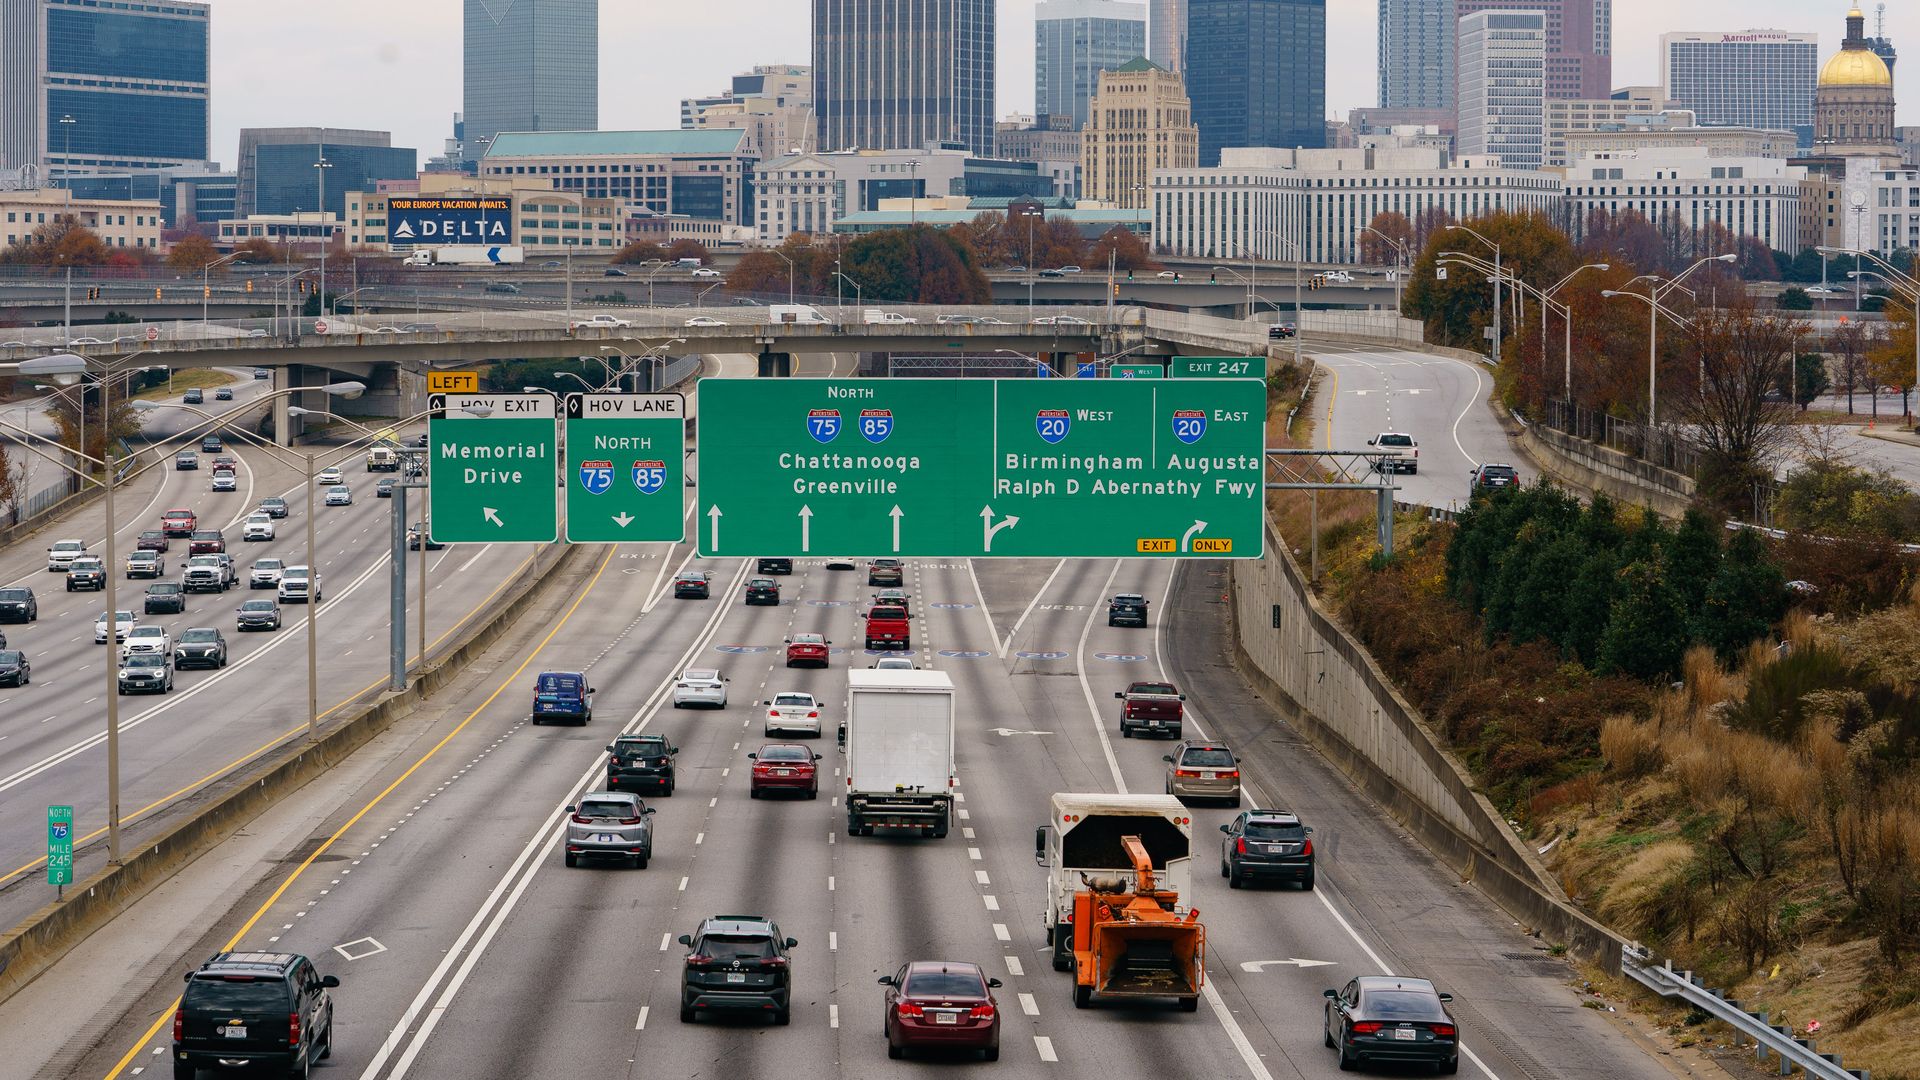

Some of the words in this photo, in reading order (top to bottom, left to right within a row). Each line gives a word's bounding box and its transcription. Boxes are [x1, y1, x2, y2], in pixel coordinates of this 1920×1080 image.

[1721, 34, 1757, 42] Marriott
[422, 220, 506, 236] DELTA
[1189, 363, 1212, 372] EXIT
[1218, 362, 1249, 374] 247
[434, 376, 472, 388] LEFT
[828, 386, 874, 398] NORTH
[505, 400, 540, 412] EXIT
[590, 400, 623, 412] HOV
[633, 400, 675, 412] LANE
[1077, 410, 1113, 421] WEST
[1214, 410, 1248, 422] EAST
[813, 420, 836, 435] 75
[864, 420, 888, 435] 85
[1042, 420, 1064, 436] 20
[1178, 420, 1200, 436] 20
[595, 436, 651, 449] NORTH
[442, 443, 545, 458] Memorial
[779, 454, 920, 473] Chattanooga
[1006, 454, 1143, 474] Birmingham
[1168, 454, 1259, 474] Augusta
[464, 468, 522, 484] Drive
[584, 469, 611, 488] 75
[636, 469, 663, 488] 85
[794, 478, 898, 494] Greenville
[998, 479, 1056, 498] Ralph
[1066, 480, 1080, 494] D
[1092, 479, 1202, 498] Abernathy
[1215, 479, 1256, 498] Fwy
[1142, 541, 1170, 550] EXIT
[1195, 541, 1230, 550] ONLY
[50, 808, 71, 818] NORTH
[53, 826, 67, 836] 75
[50, 844, 70, 854] MILE
[50, 855, 70, 866] 245
